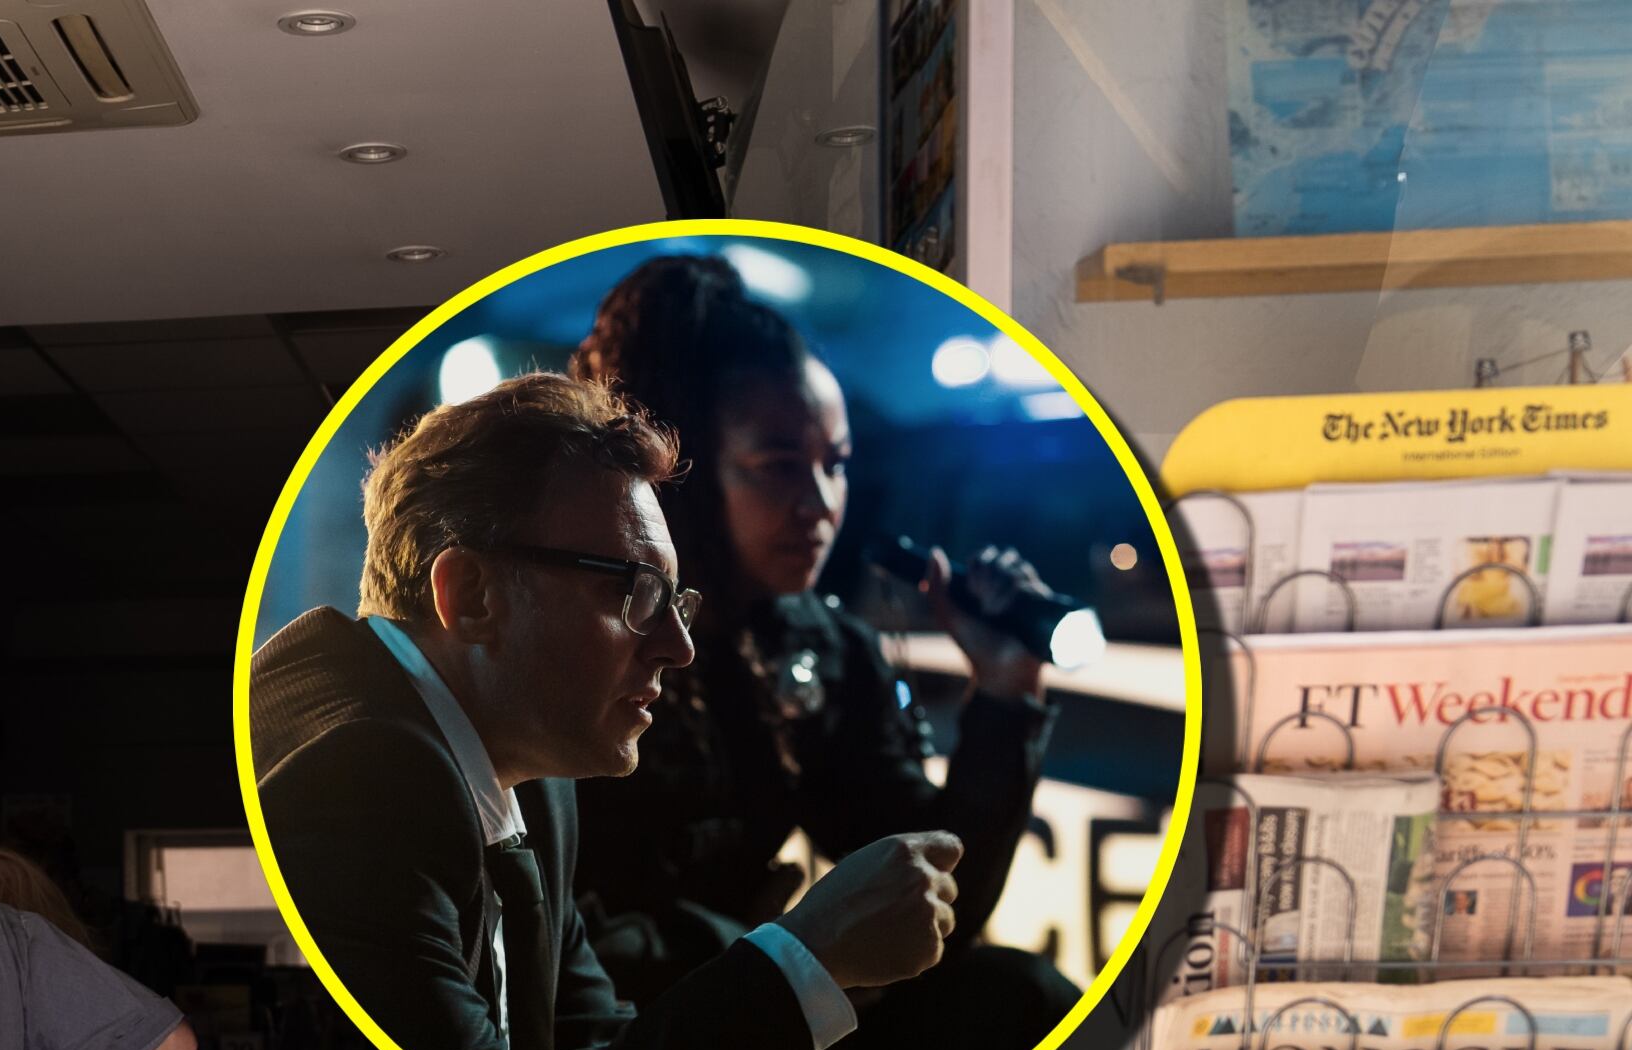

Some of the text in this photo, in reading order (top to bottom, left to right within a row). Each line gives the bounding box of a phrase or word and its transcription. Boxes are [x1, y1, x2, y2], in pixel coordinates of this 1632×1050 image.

[1322, 404, 1610, 444] The New York Times
